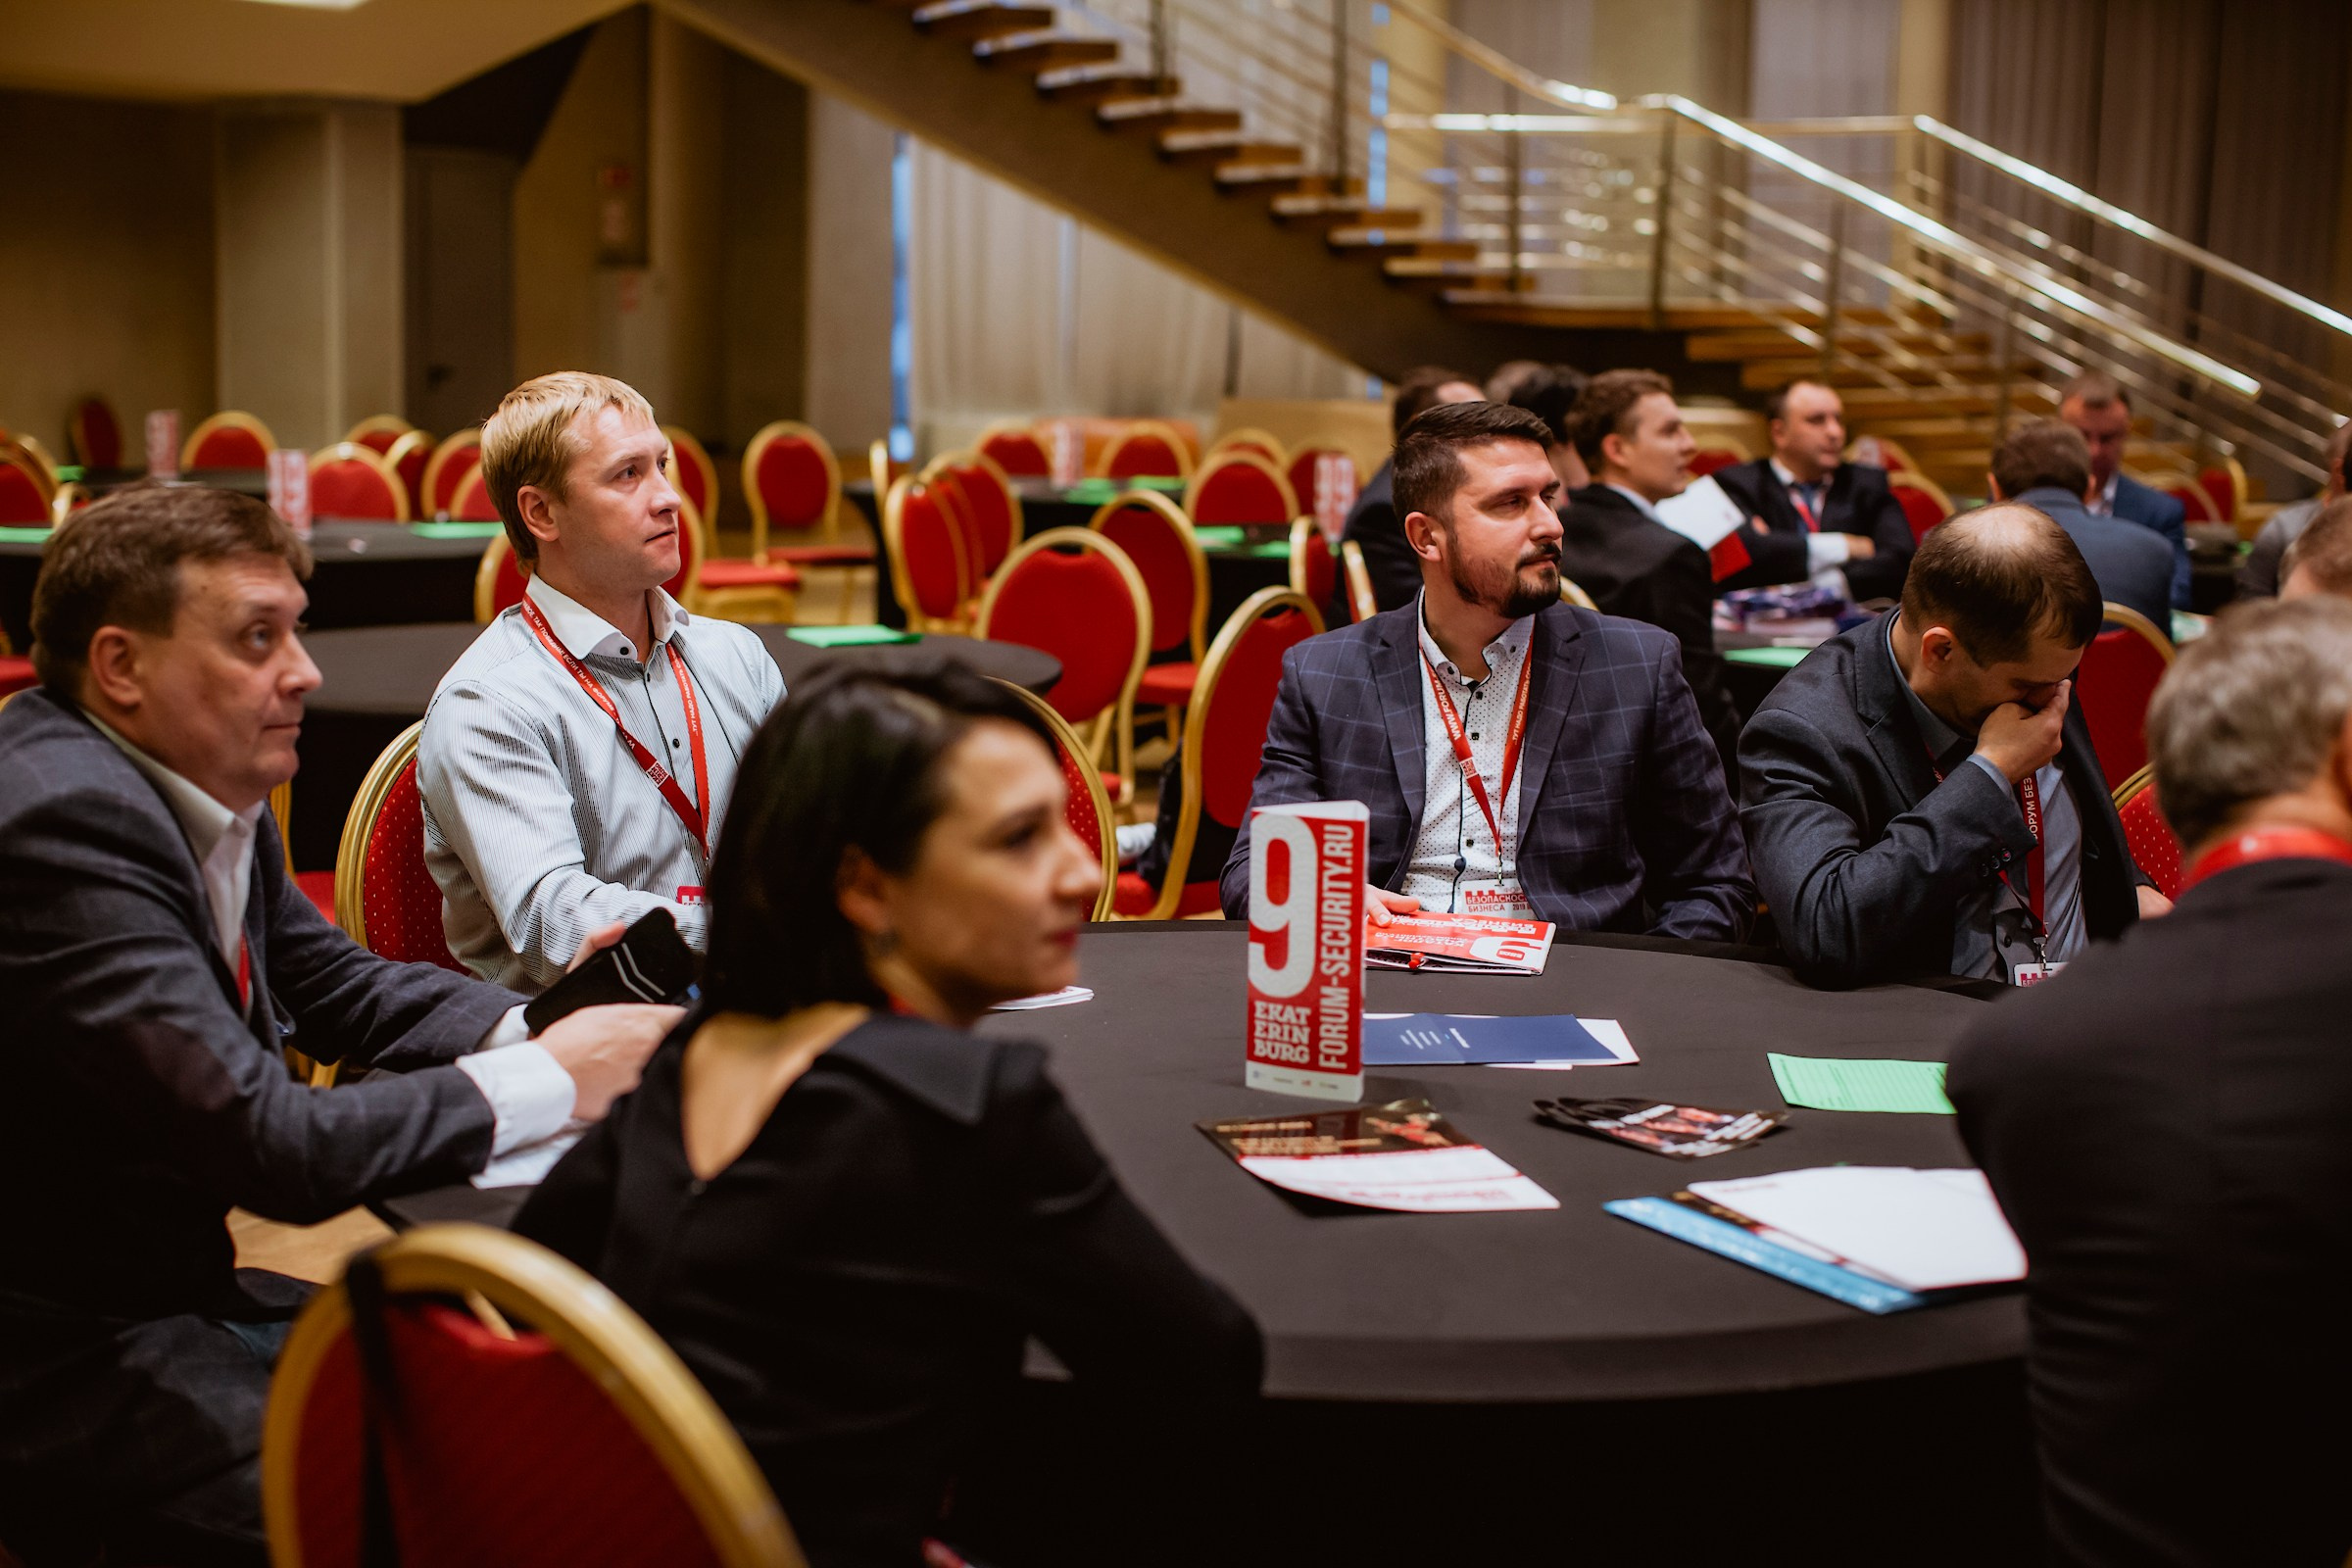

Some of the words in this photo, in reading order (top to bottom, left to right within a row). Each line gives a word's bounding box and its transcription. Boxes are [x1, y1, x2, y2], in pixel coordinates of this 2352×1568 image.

[533, 616, 543, 628] ТАК
[563, 654, 579, 670] ЕСЛИ
[577, 669, 587, 680] ТЫ
[584, 679, 594, 689] НА
[678, 669, 692, 700] РАБОТАТЬ
[1518, 682, 1531, 710] РАБОТАТЬ
[687, 700, 696, 719] НАДО
[1513, 710, 1524, 730] НАДО
[1249, 811, 1318, 999] 9
[1467, 894, 1528, 905] БЕЗОПАСНОС
[1468, 904, 1506, 912] БИЗНЕСА
[1318, 823, 1355, 1070] FORUM-SECURITY.RU
[1253, 1000, 1312, 1025] EKAT
[1253, 1019, 1311, 1046] ERIN
[1253, 1039, 1310, 1065] BURG
